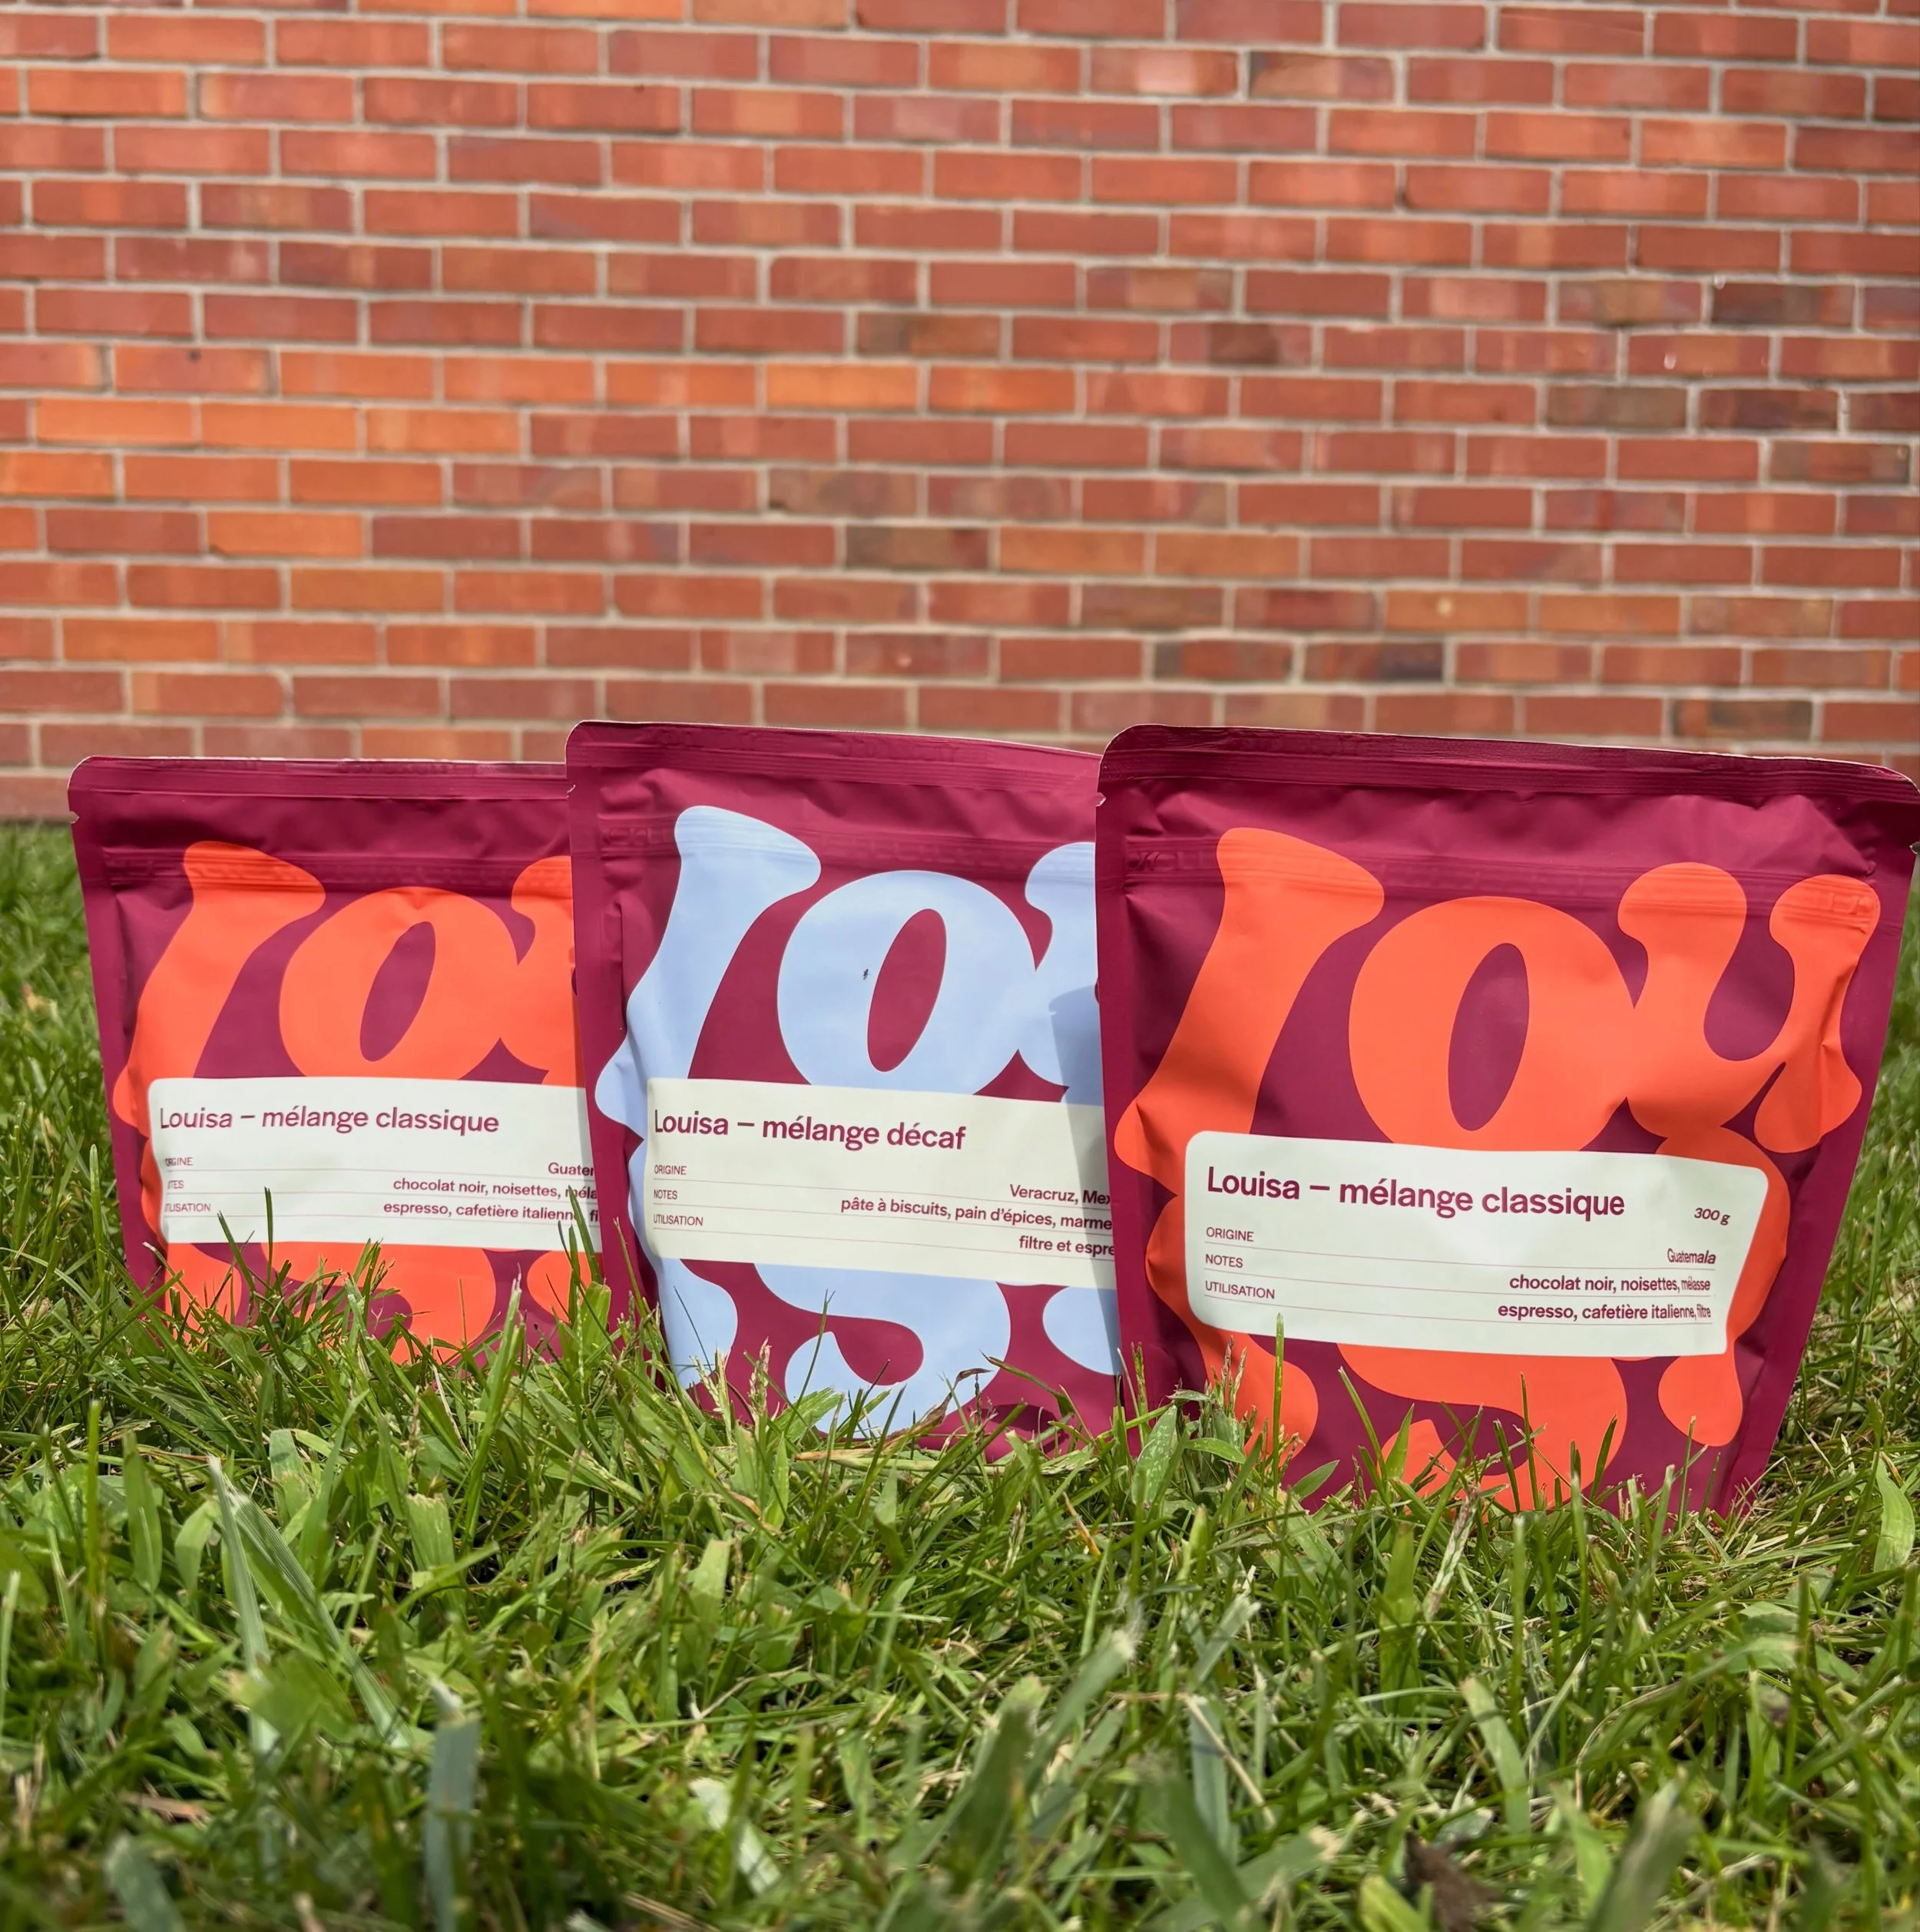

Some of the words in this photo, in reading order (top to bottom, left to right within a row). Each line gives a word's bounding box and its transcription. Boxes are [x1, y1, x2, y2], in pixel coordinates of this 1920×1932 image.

[160, 1107, 233, 1130] Louisa
[261, 1105, 369, 1134] mélange
[376, 1106, 500, 1137] classique
[654, 1108, 729, 1136] Louisa
[762, 1115, 880, 1152] mélange
[886, 1121, 967, 1150] décaf
[654, 1164, 687, 1176] ORIGINE
[392, 1177, 455, 1192] chocolat
[458, 1181, 489, 1196] noir,
[492, 1183, 561, 1199] noisettes,
[653, 1189, 678, 1200] NOTES
[1009, 1183, 1079, 1205] Veracruz,
[1207, 1166, 1300, 1200] Louisa
[1339, 1177, 1474, 1219] mélange
[1481, 1186, 1625, 1222] classique
[382, 1203, 452, 1218] espresso,
[455, 1203, 519, 1218] cafetière
[522, 1206, 577, 1221] italienn
[653, 1213, 703, 1227] UTILISATION
[840, 1196, 875, 1213] pâte
[877, 1197, 886, 1212] à
[889, 1198, 952, 1221] biscuits,
[955, 1205, 987, 1222] pain
[1060, 1216, 1113, 1230] marme
[1693, 1206, 1720, 1222] 300
[1720, 1213, 1731, 1226] g
[1019, 1235, 1054, 1251] filtre
[1056, 1239, 1072, 1252] et
[1205, 1226, 1255, 1243] ORIGINE
[1204, 1253, 1244, 1269] NOTES
[1667, 1248, 1717, 1265] Guatemala
[1204, 1279, 1276, 1301] UTILISATION
[1508, 1274, 1581, 1291] chocolat
[1584, 1275, 1617, 1294] noir,
[1620, 1276, 1680, 1294] noisettes,
[1497, 1305, 1578, 1322] espresso,
[1581, 1304, 1648, 1320] cafetière
[1650, 1304, 1697, 1321] italienne,
